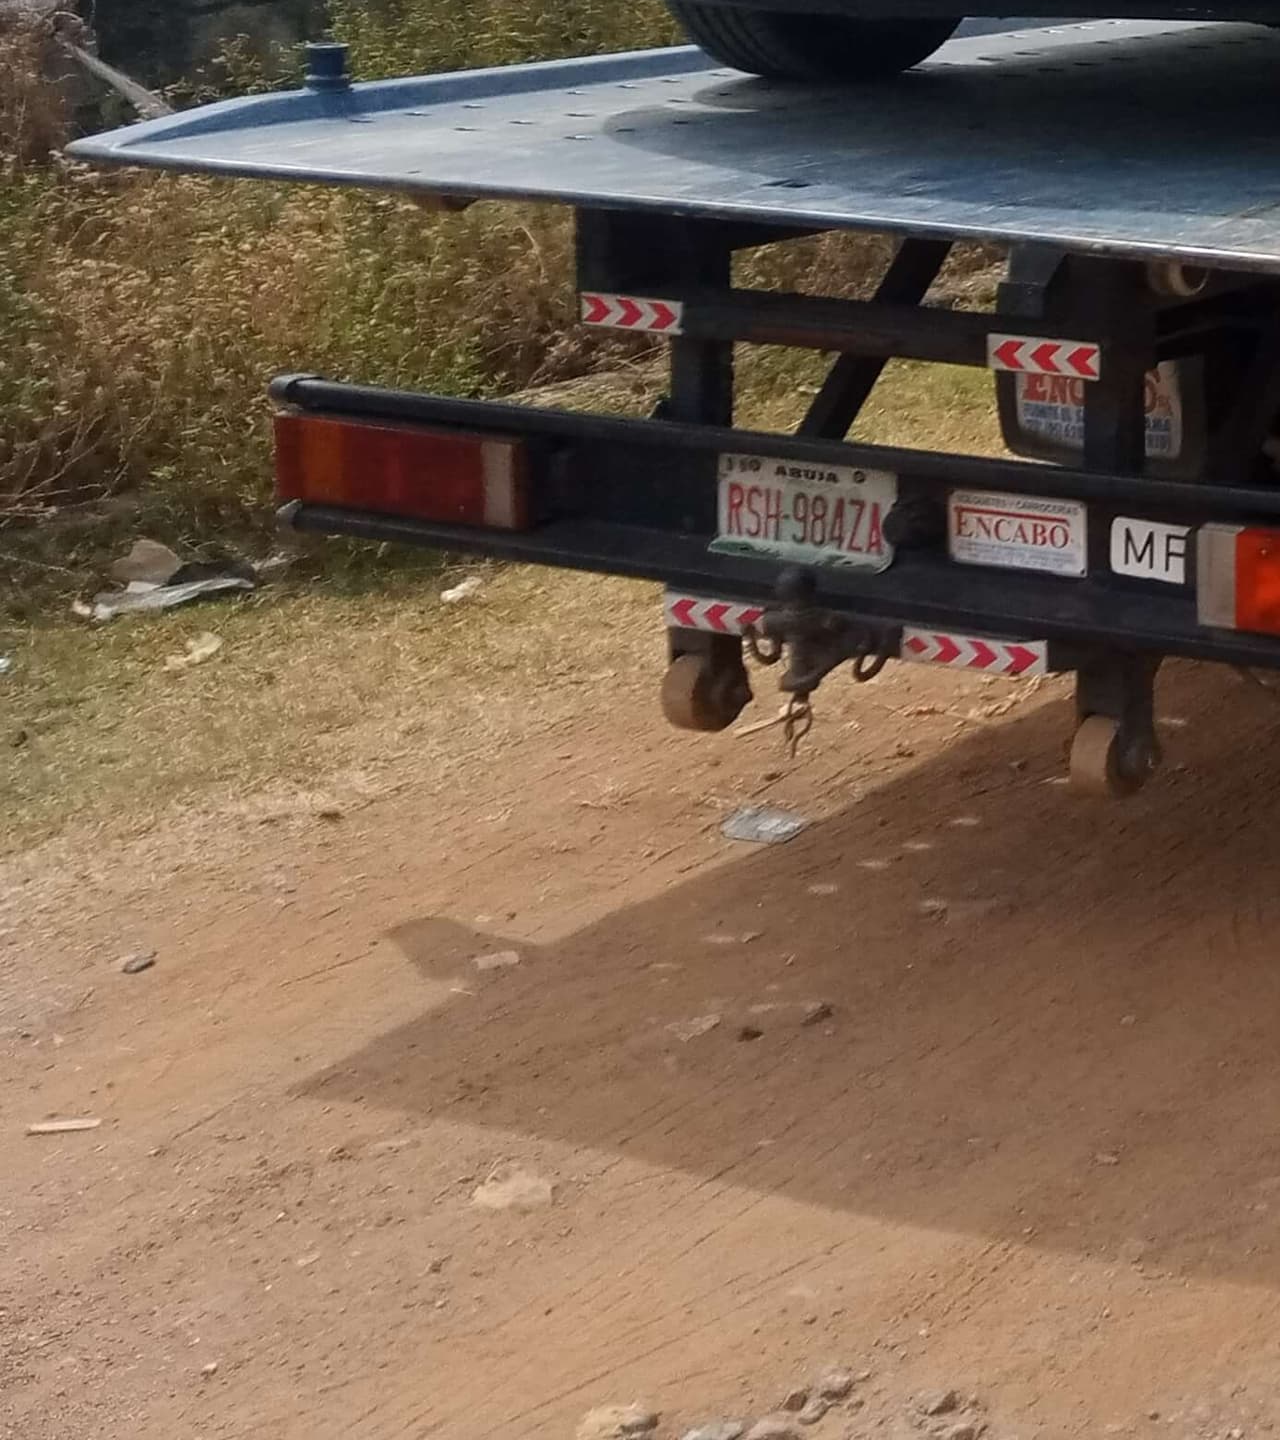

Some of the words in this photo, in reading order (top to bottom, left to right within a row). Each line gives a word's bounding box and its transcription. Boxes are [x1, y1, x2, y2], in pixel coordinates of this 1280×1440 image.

[774, 465, 839, 484] ABUJA
[727, 482, 882, 555] RSH-984ZA
[954, 507, 1069, 549] ENCABO
